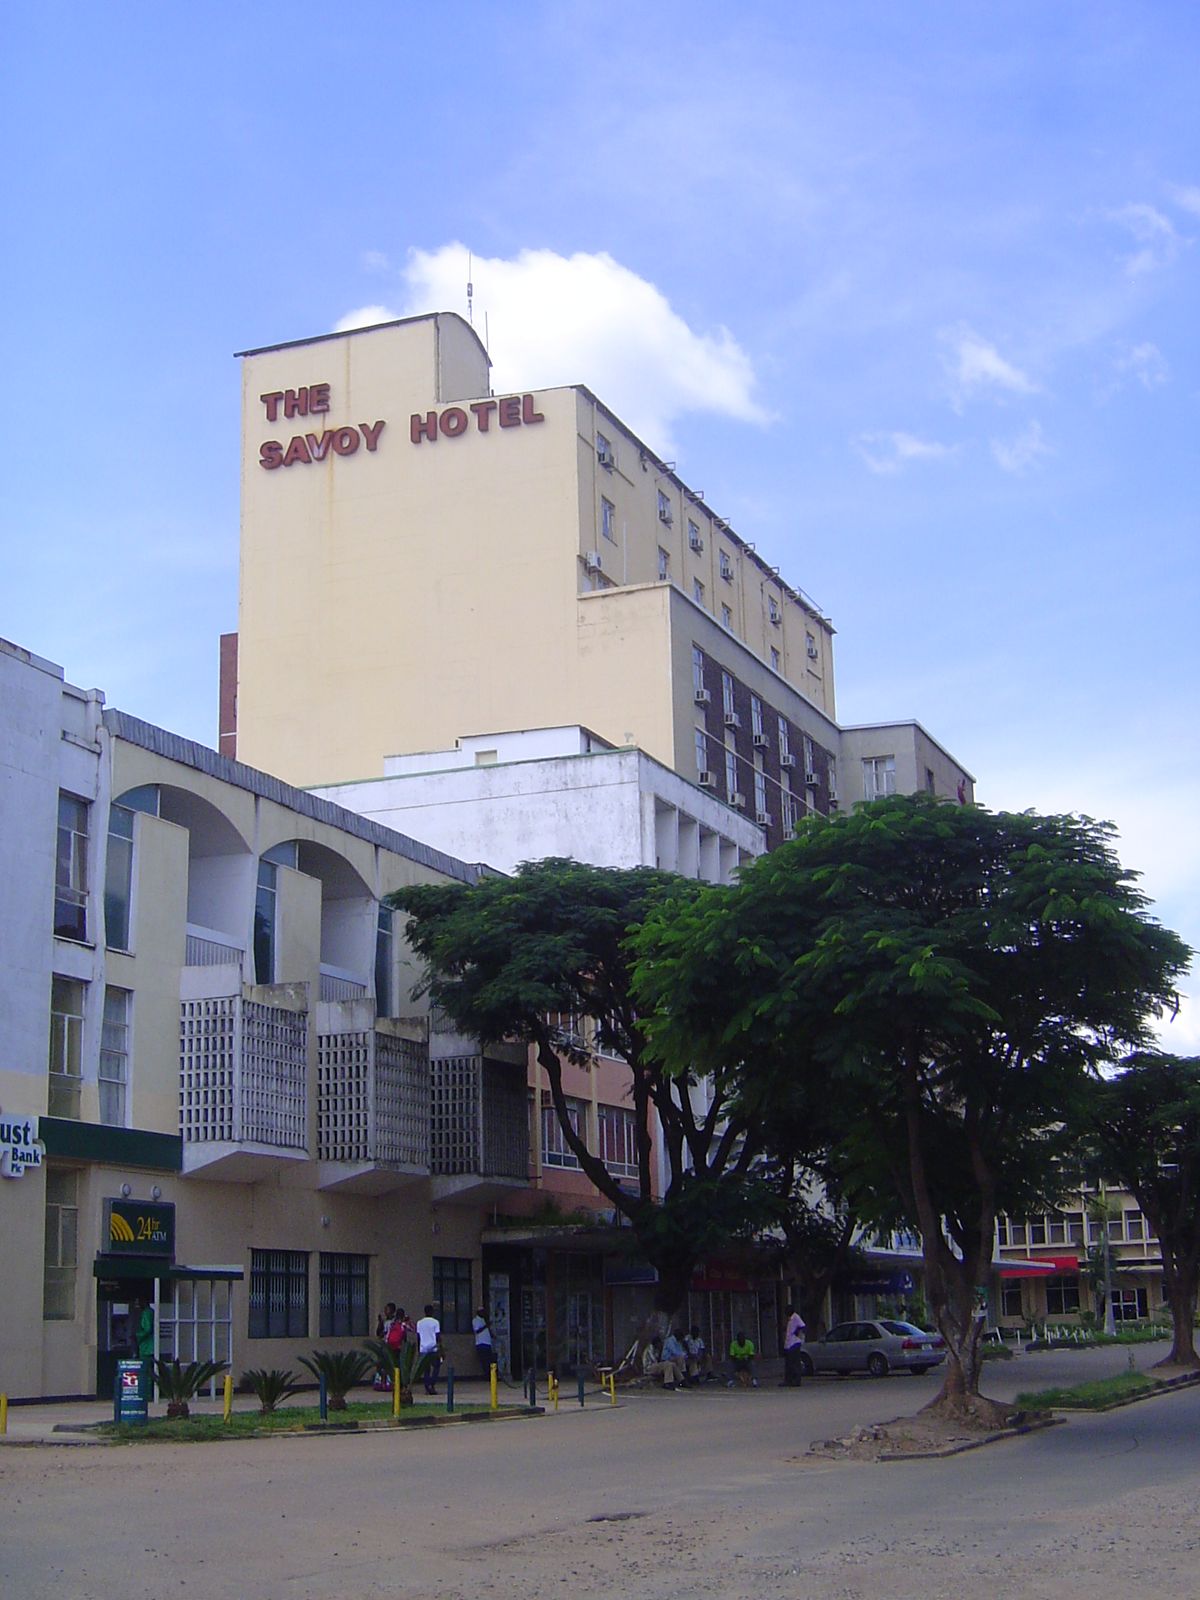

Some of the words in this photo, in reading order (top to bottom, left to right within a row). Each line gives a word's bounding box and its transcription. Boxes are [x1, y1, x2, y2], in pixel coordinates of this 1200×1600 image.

[260, 383, 330, 422] THE
[259, 420, 386, 470] SAVOY
[410, 394, 545, 444] HOTEL
[0, 1121, 31, 1146] ust
[12, 1147, 40, 1164] Bank
[137, 1216, 152, 1240] 24
[152, 1231, 167, 1241] ATM
